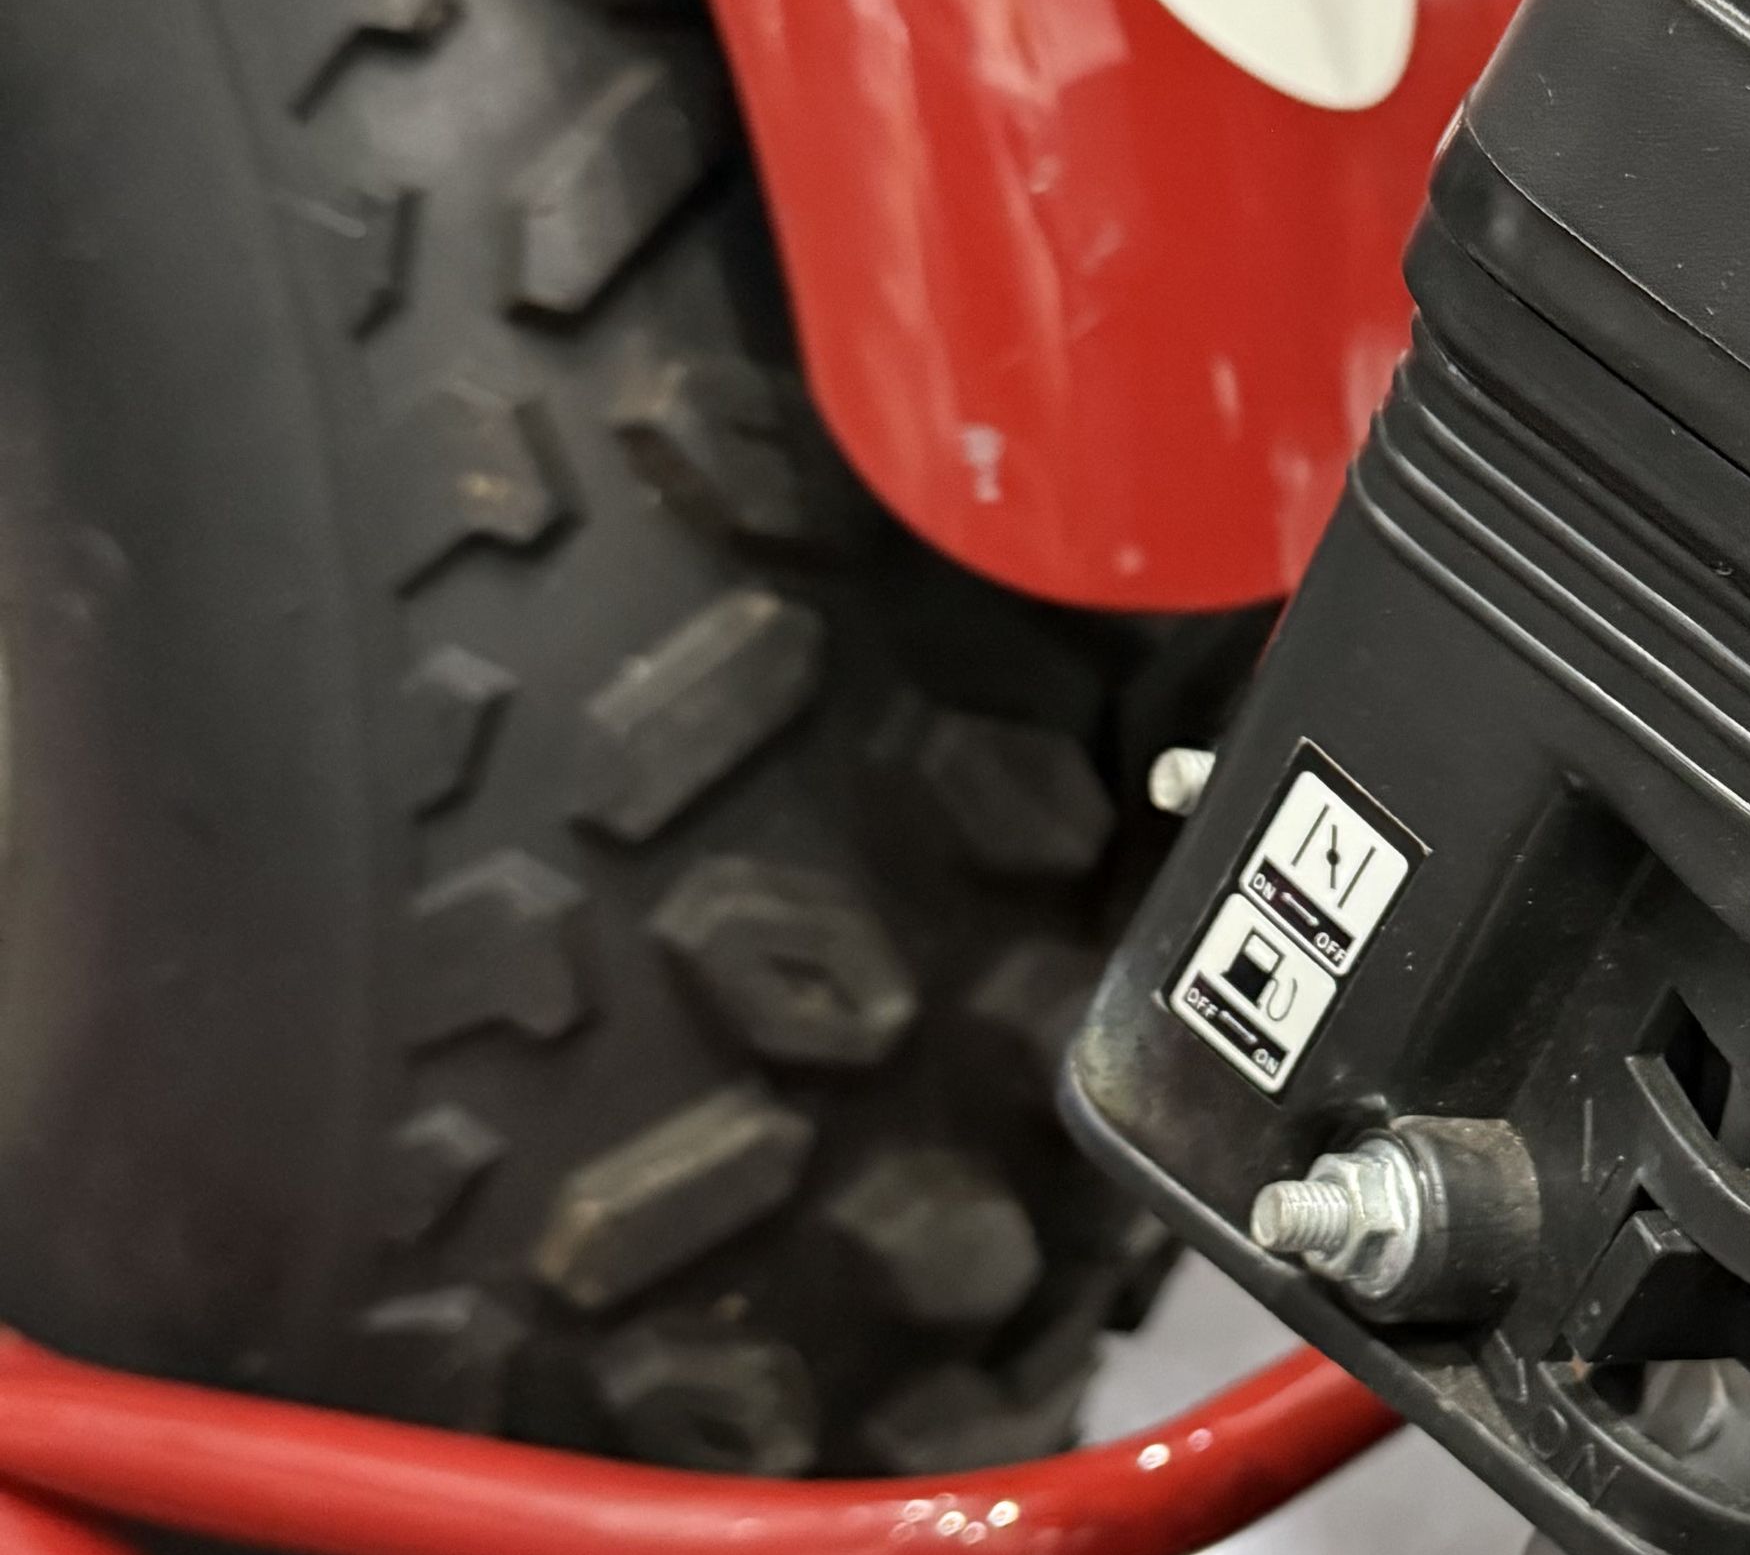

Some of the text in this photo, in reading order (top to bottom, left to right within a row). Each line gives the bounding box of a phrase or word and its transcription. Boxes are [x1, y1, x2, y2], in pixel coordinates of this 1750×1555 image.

[1252, 871, 1348, 965] ON OFF
[1186, 987, 1280, 1075] OFF ON
